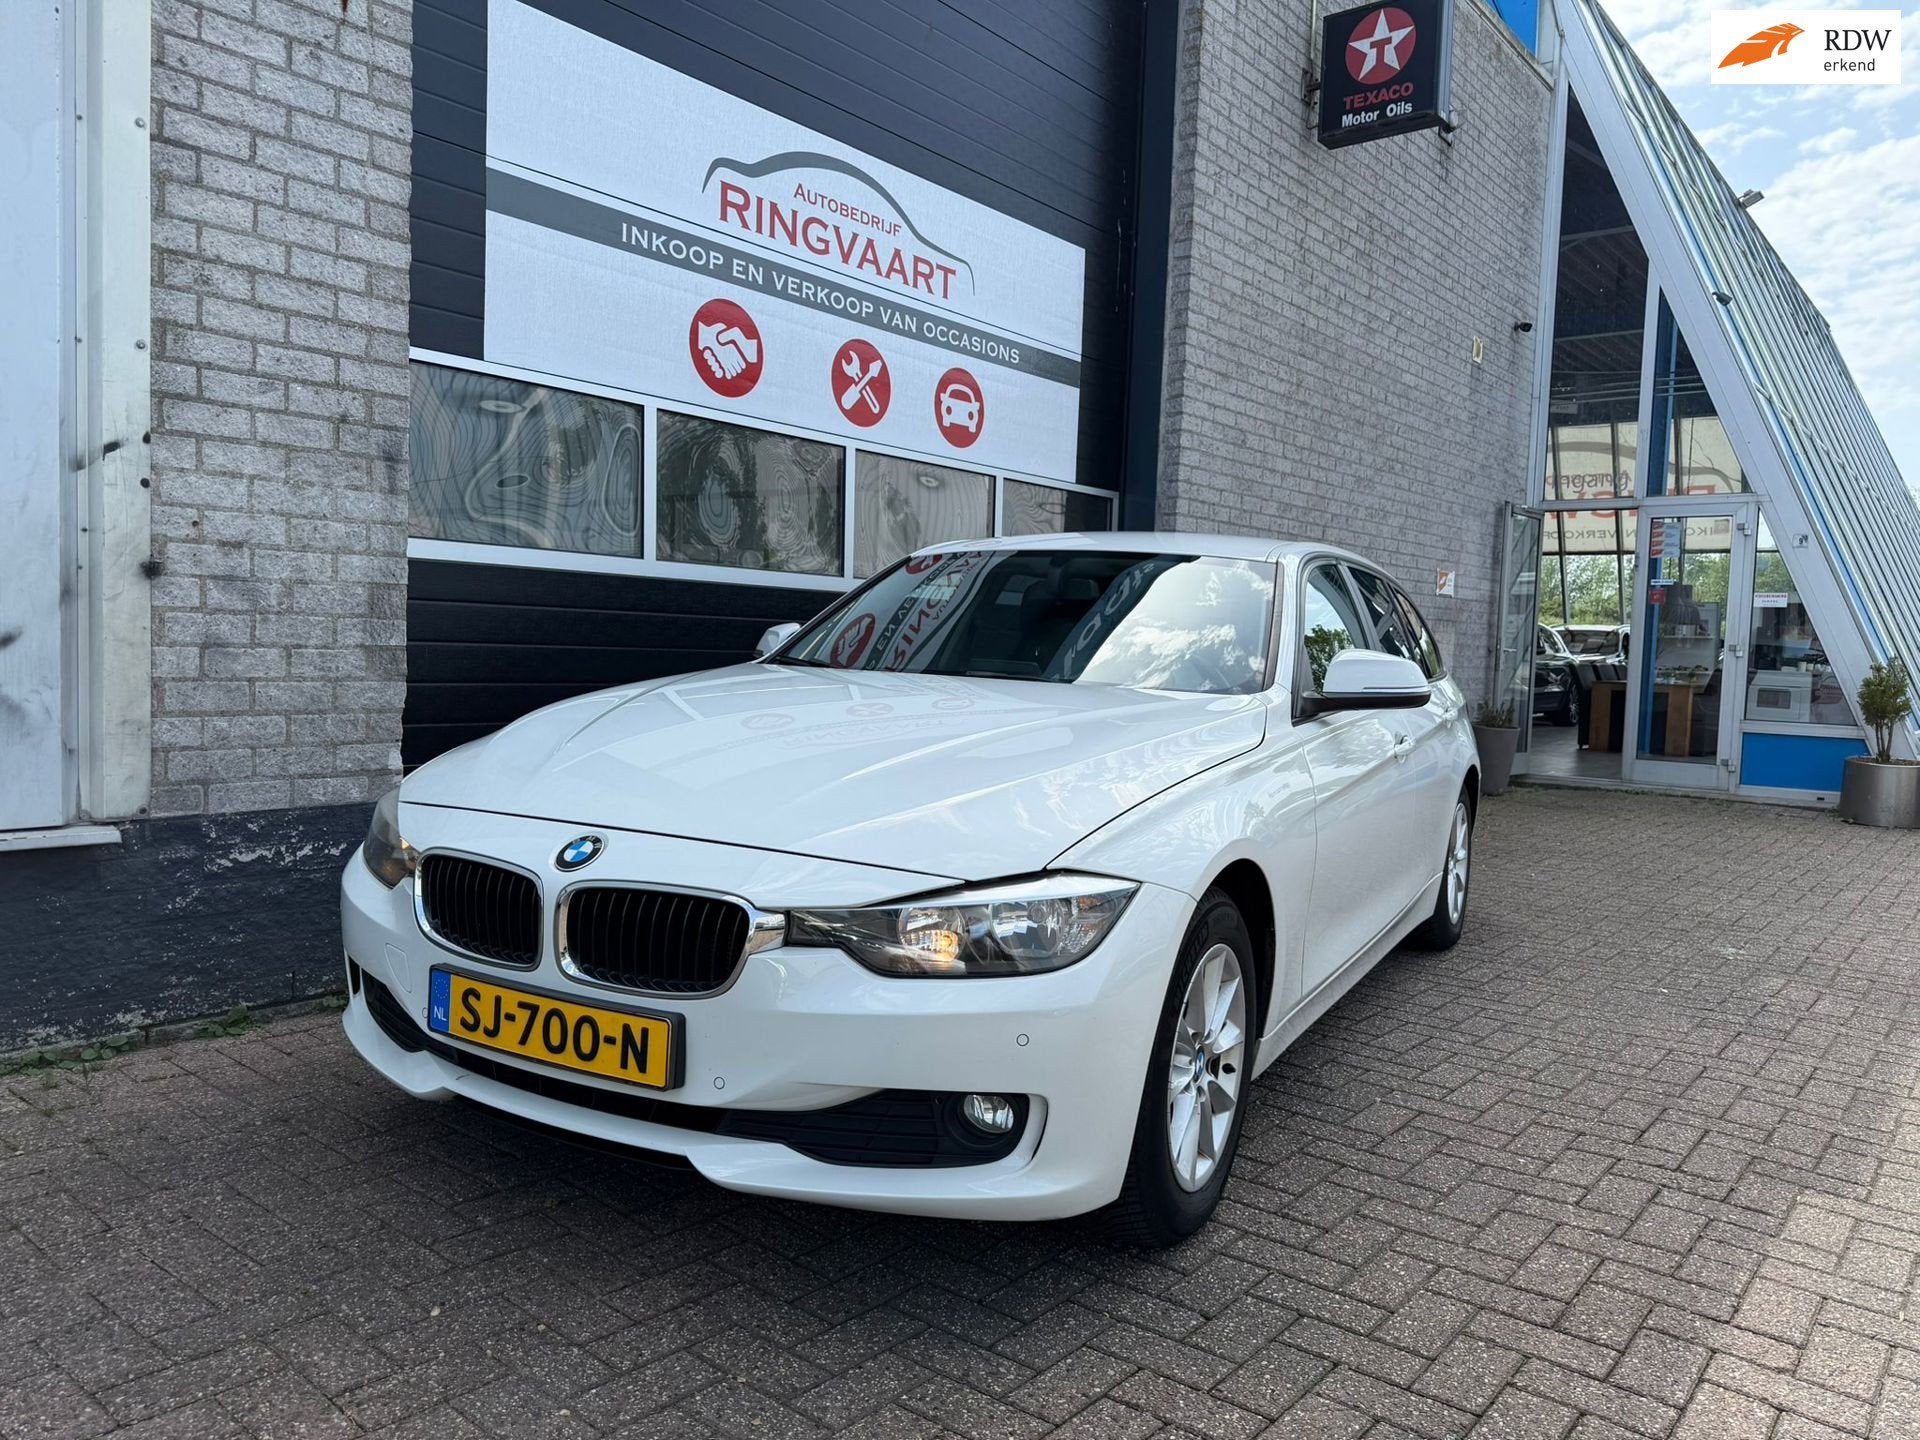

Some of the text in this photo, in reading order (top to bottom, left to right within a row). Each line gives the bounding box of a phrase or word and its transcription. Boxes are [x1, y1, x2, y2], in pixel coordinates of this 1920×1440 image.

[1342, 101, 1413, 128] Motor Oils
[1344, 82, 1414, 109] TEXACO
[793, 182, 902, 238] AUTOBEDRIJF
[718, 180, 957, 299] RINGVAART
[621, 222, 1021, 365] INKOOP EN VERKOOP VAN OCCASIONS
[433, 1005, 447, 1021] NL
[460, 988, 649, 1073] SJ-700-N
